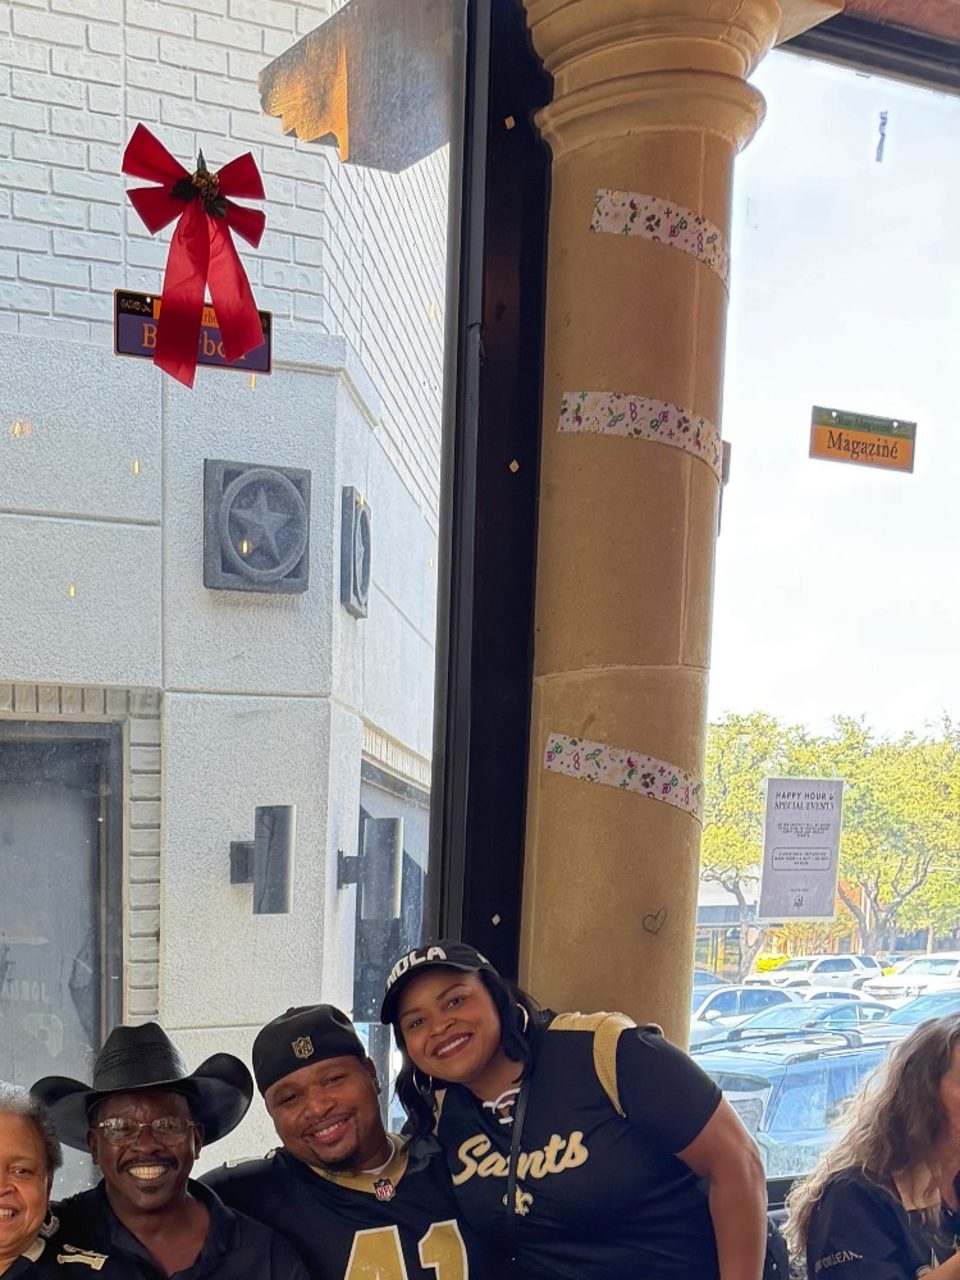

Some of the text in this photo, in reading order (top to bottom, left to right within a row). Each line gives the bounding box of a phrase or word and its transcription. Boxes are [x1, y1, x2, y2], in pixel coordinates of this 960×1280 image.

[826, 430, 899, 460] Magazine
[775, 791, 801, 800] HAPPY
[804, 791, 827, 801] HOUR
[452, 1131, 589, 1185] Sants
